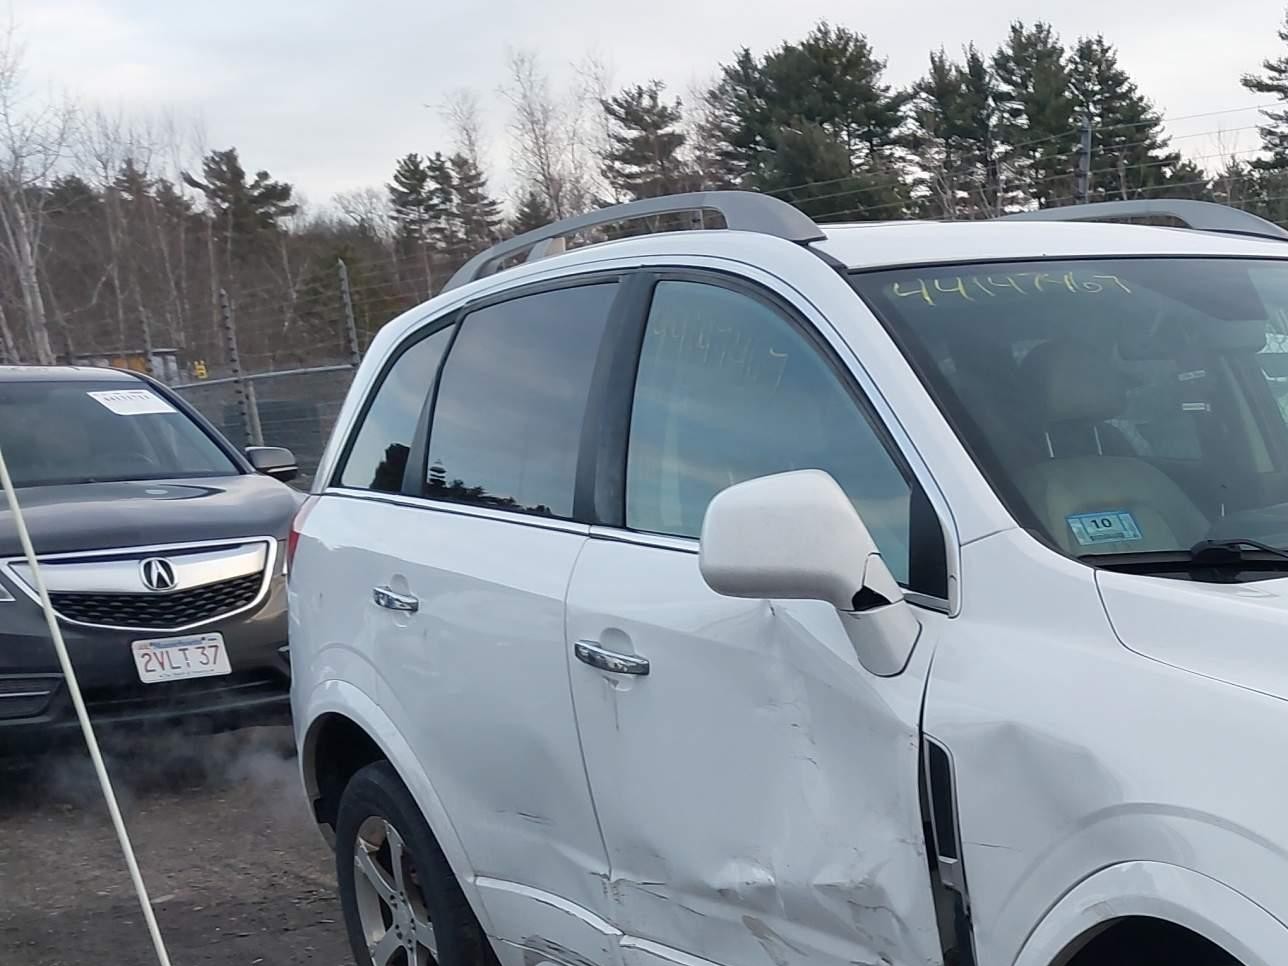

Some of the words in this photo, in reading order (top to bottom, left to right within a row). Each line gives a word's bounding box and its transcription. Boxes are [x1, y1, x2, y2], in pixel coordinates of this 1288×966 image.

[1090, 517, 1112, 530] 10
[141, 647, 191, 673] 2VLT
[195, 644, 219, 666] 37
